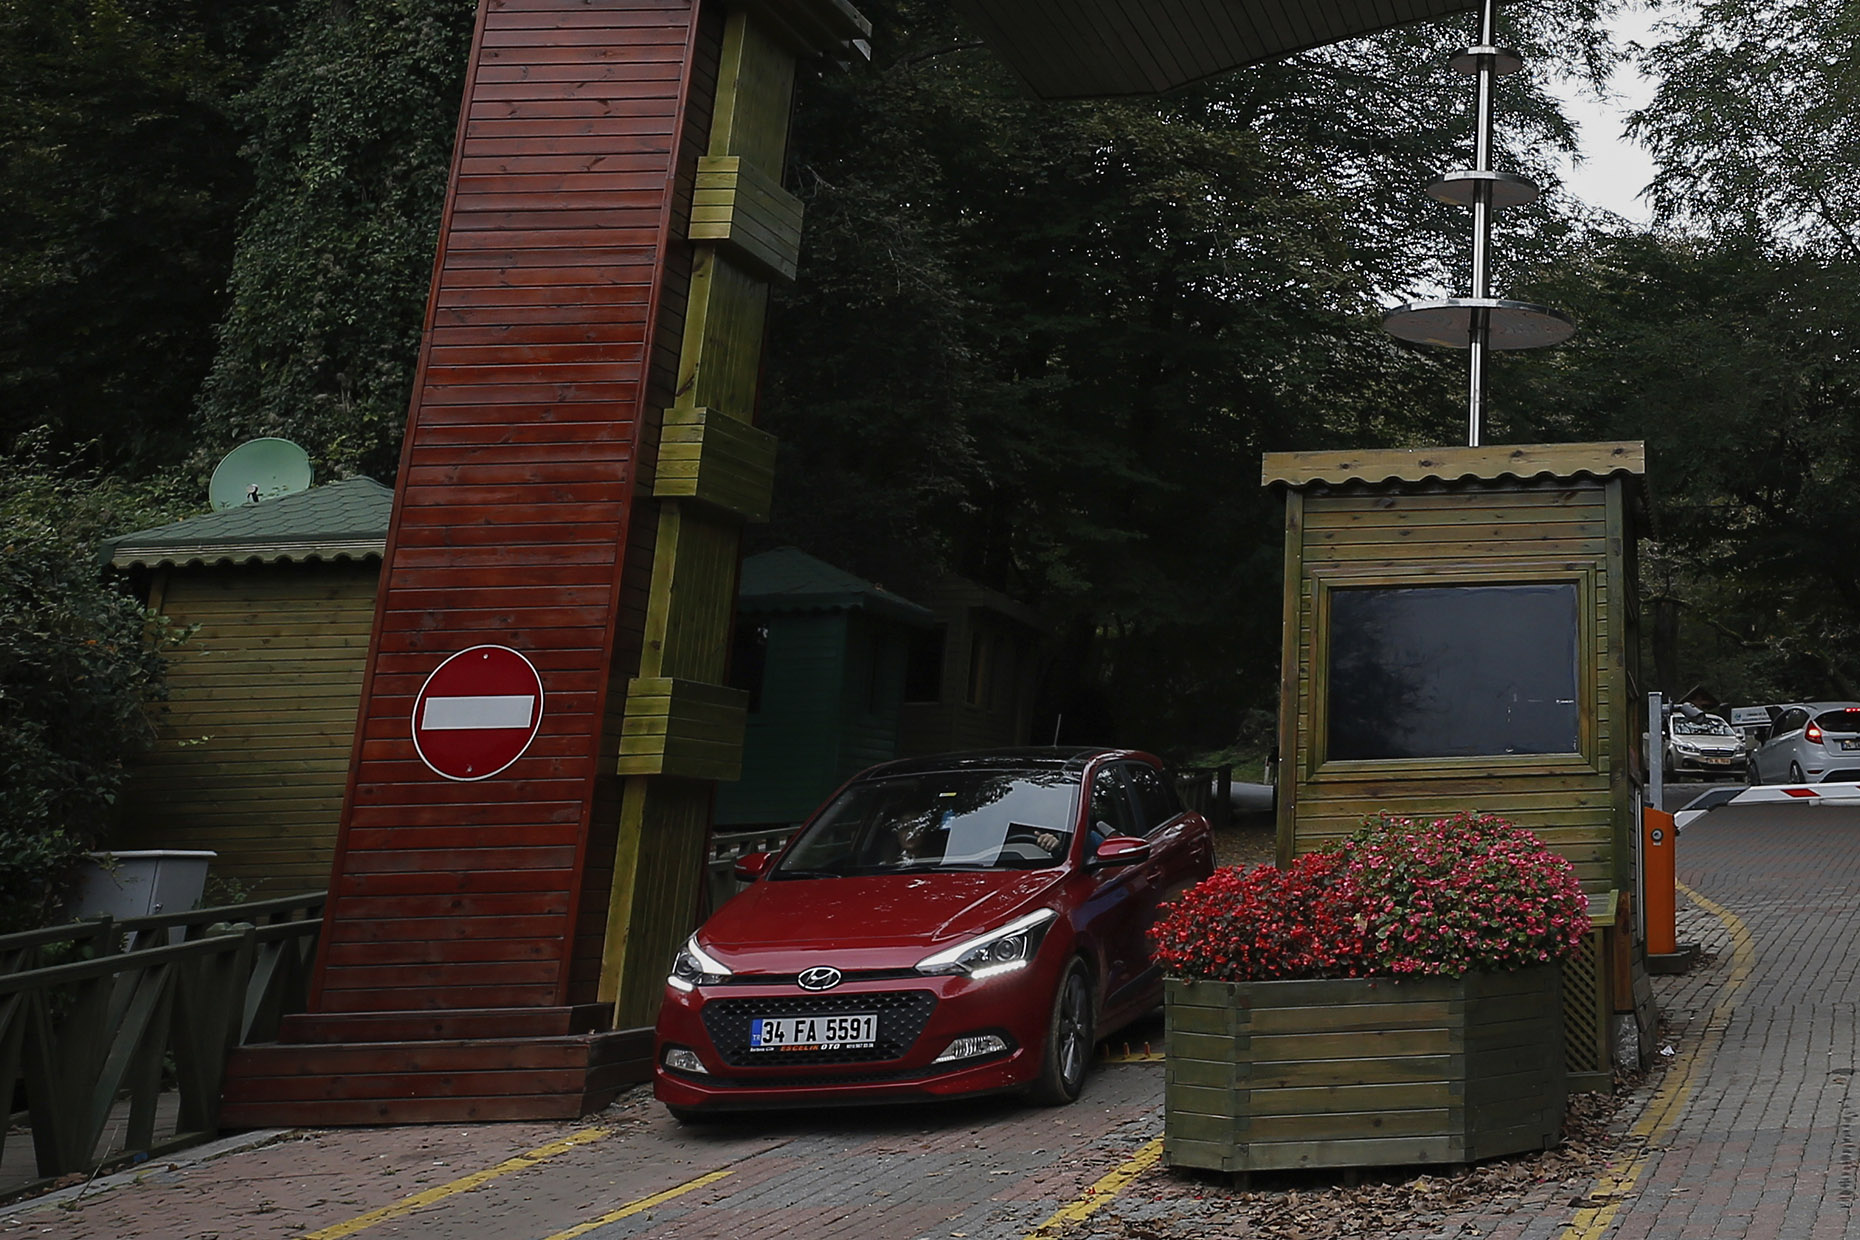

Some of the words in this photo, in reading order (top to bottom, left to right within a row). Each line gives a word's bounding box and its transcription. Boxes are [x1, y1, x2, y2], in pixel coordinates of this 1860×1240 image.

[762, 1021, 785, 1043] 34
[794, 1019, 817, 1042] FA
[825, 1017, 872, 1041] 5591
